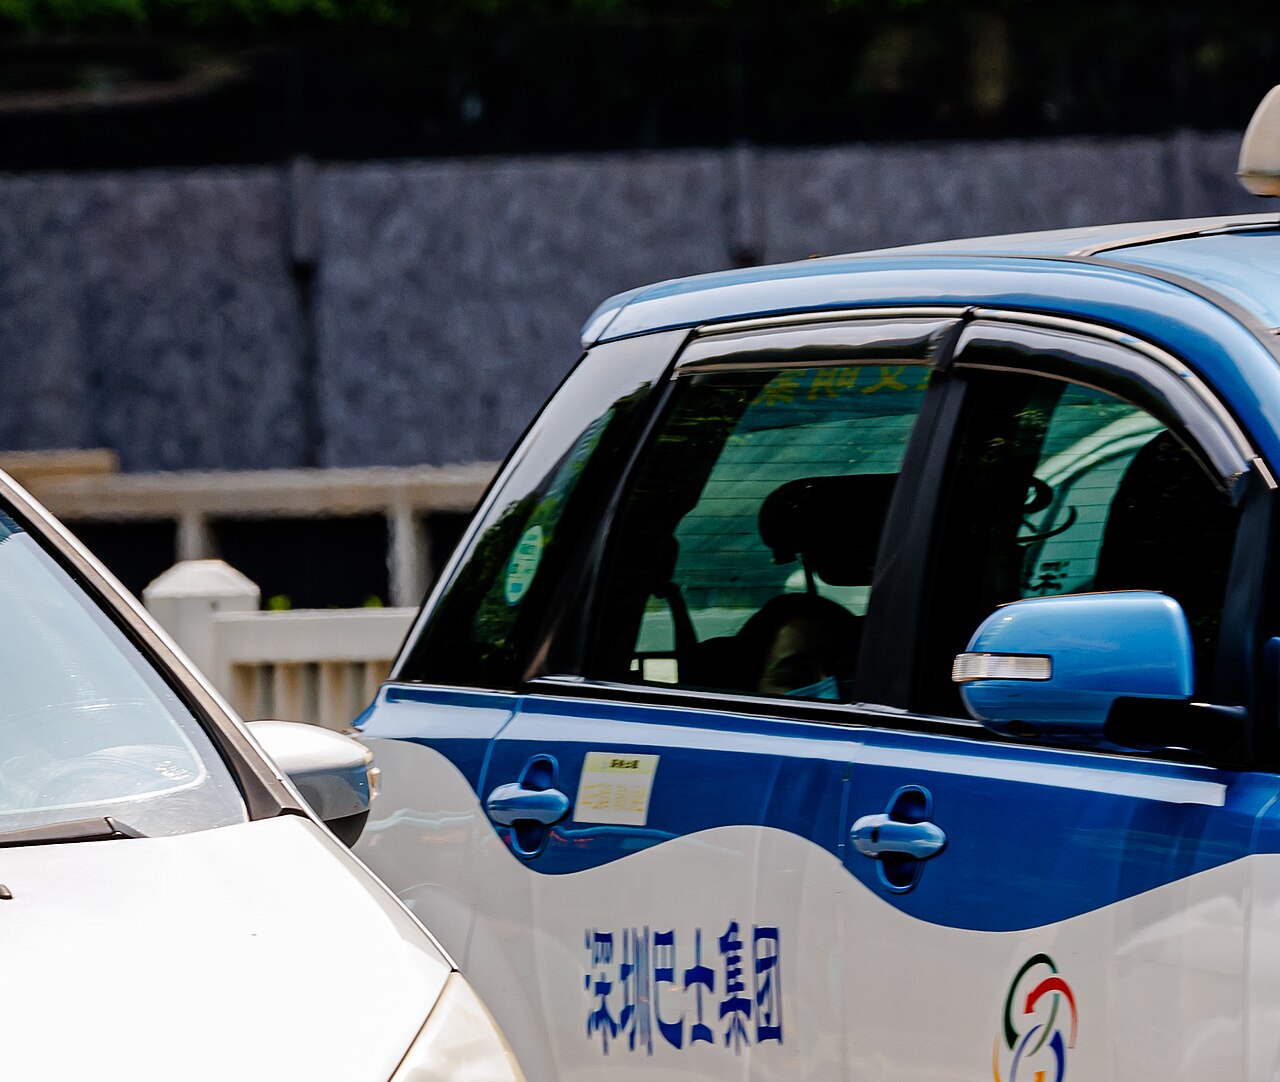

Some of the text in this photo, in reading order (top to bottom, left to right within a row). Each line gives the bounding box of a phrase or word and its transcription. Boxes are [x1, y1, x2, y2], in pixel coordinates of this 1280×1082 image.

[585, 921, 783, 1056] 深圳巴士集团
